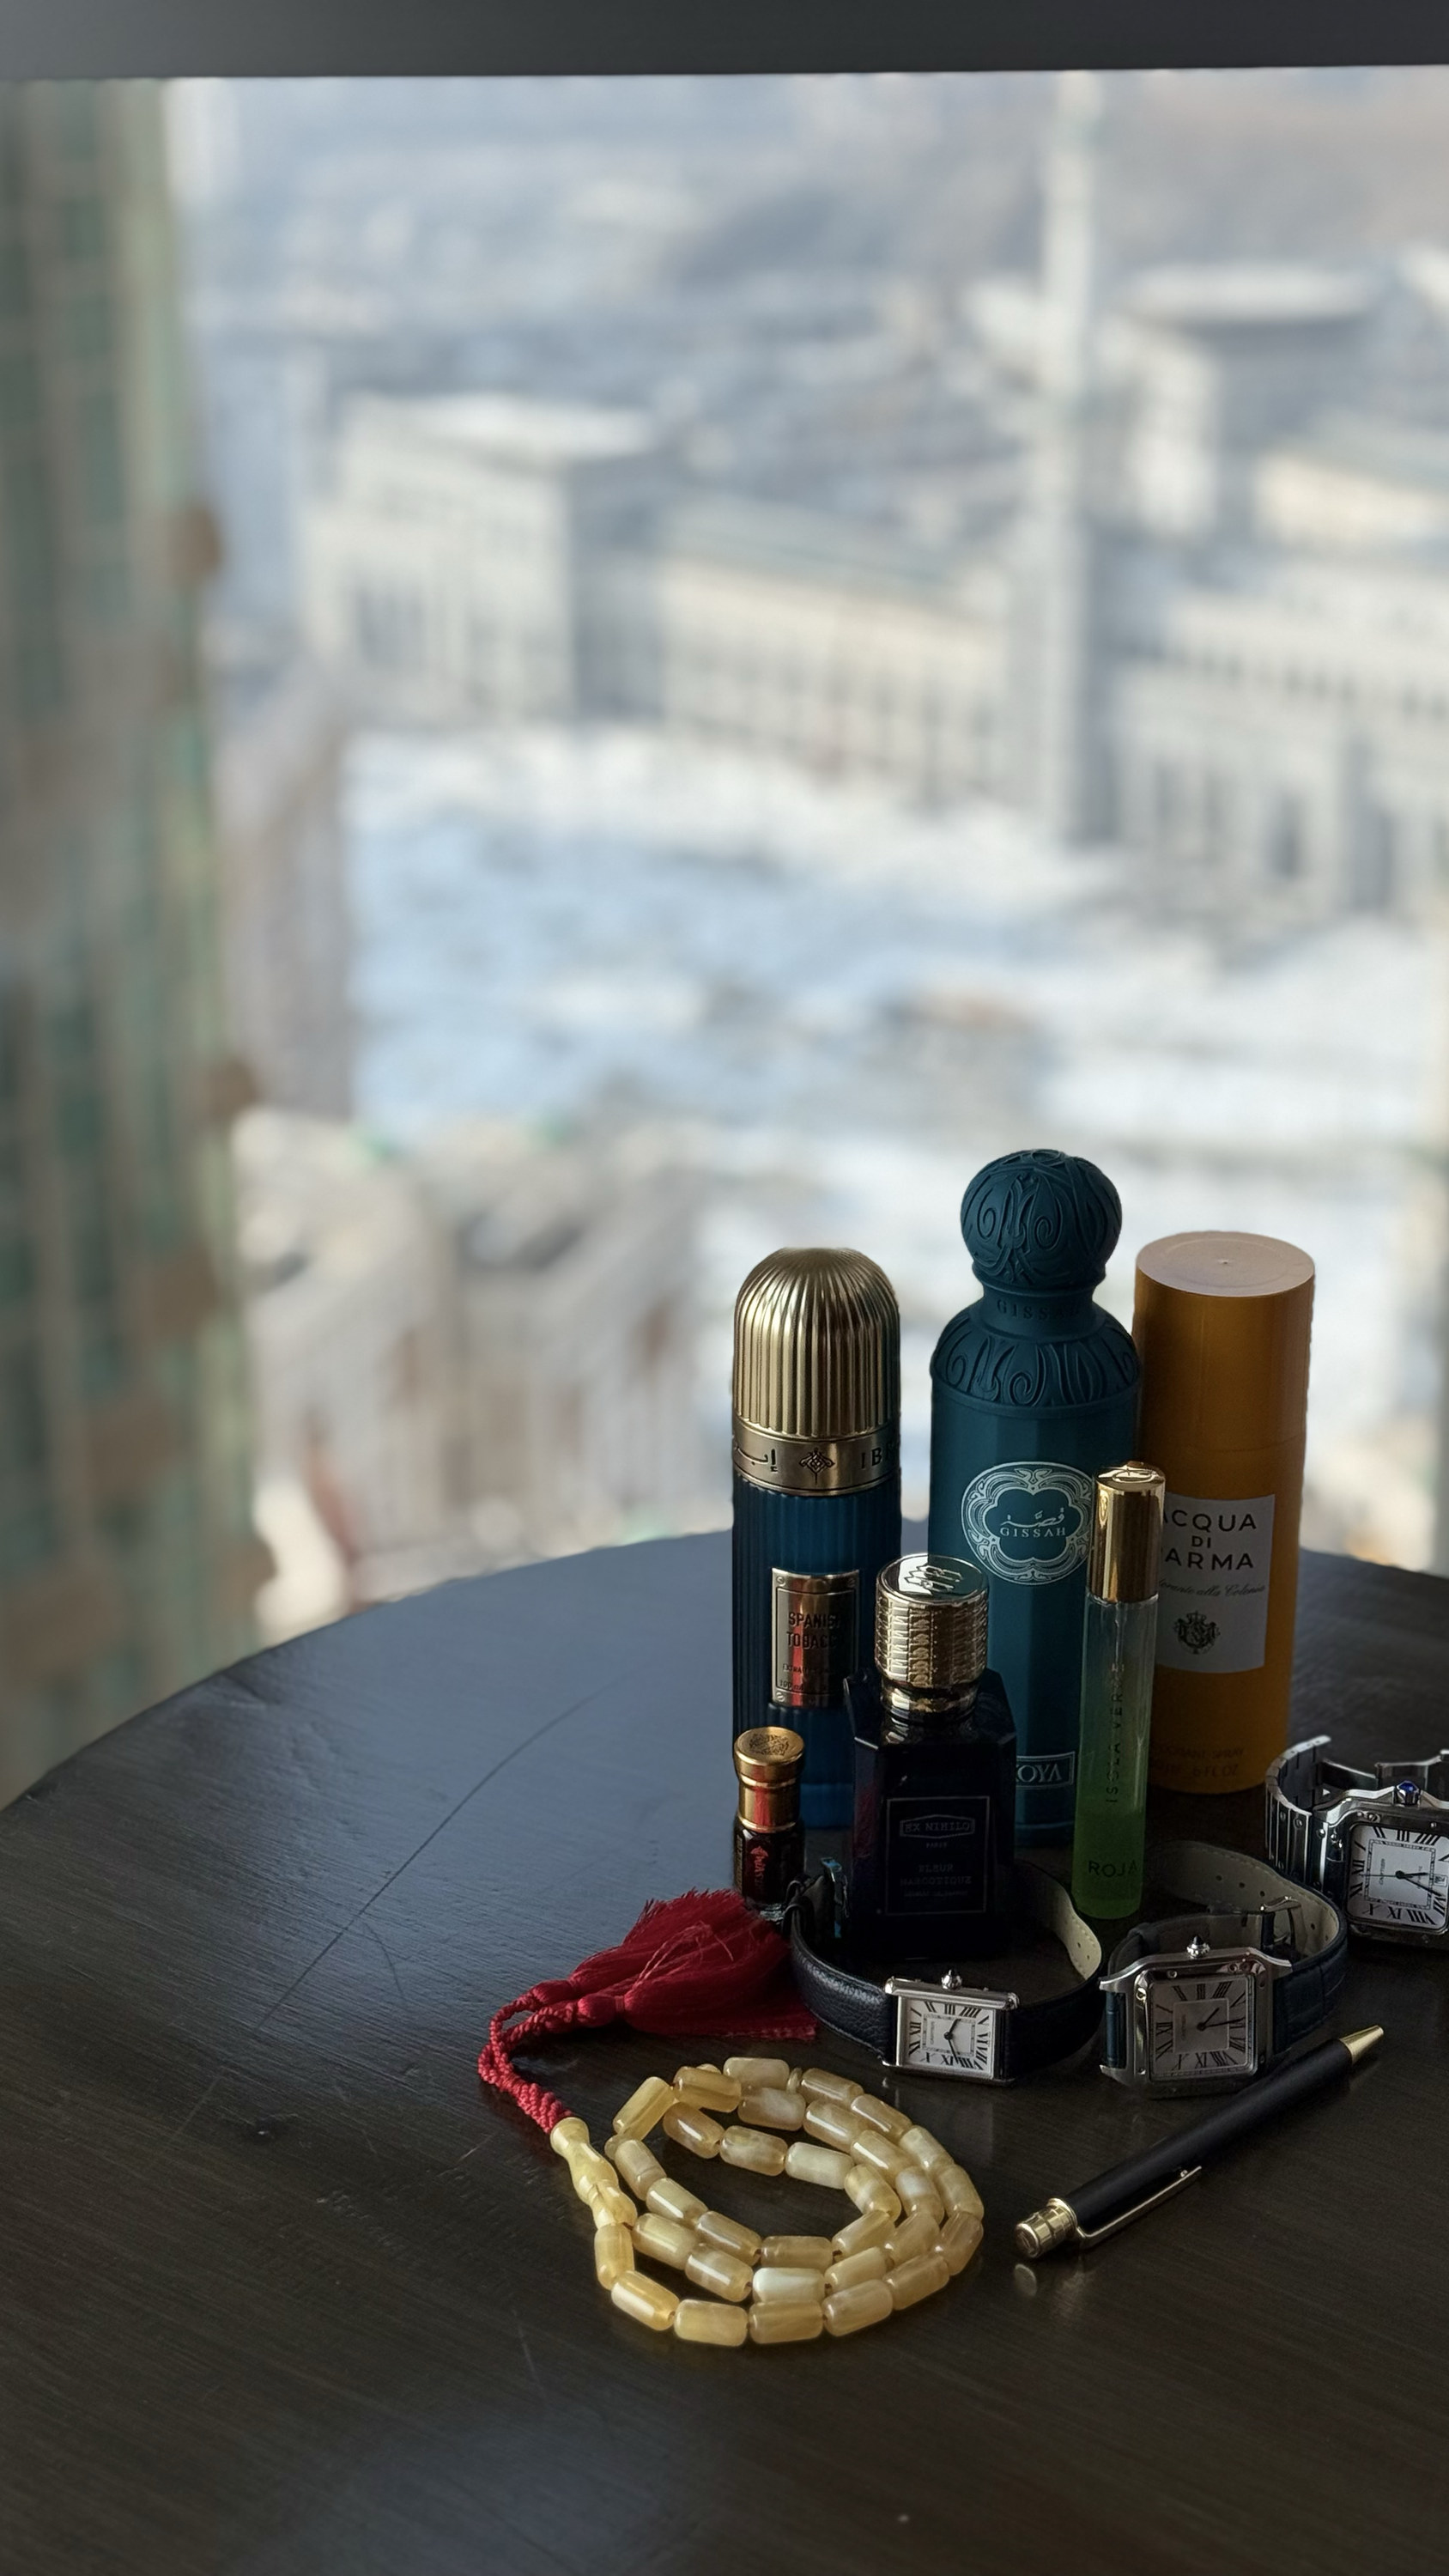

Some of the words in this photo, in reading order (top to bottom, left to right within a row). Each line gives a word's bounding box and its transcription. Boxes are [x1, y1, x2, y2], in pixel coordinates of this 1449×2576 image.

[999, 1527, 1066, 1538] GISSAH
[1191, 1535, 1211, 1548] DI
[1161, 1548, 1254, 1571] ARMA
[1397, 1830, 1410, 1842] III
[1088, 1859, 1138, 1878] ROJA
[1197, 1984, 1205, 1999] III
[944, 2004, 955, 2015] III
